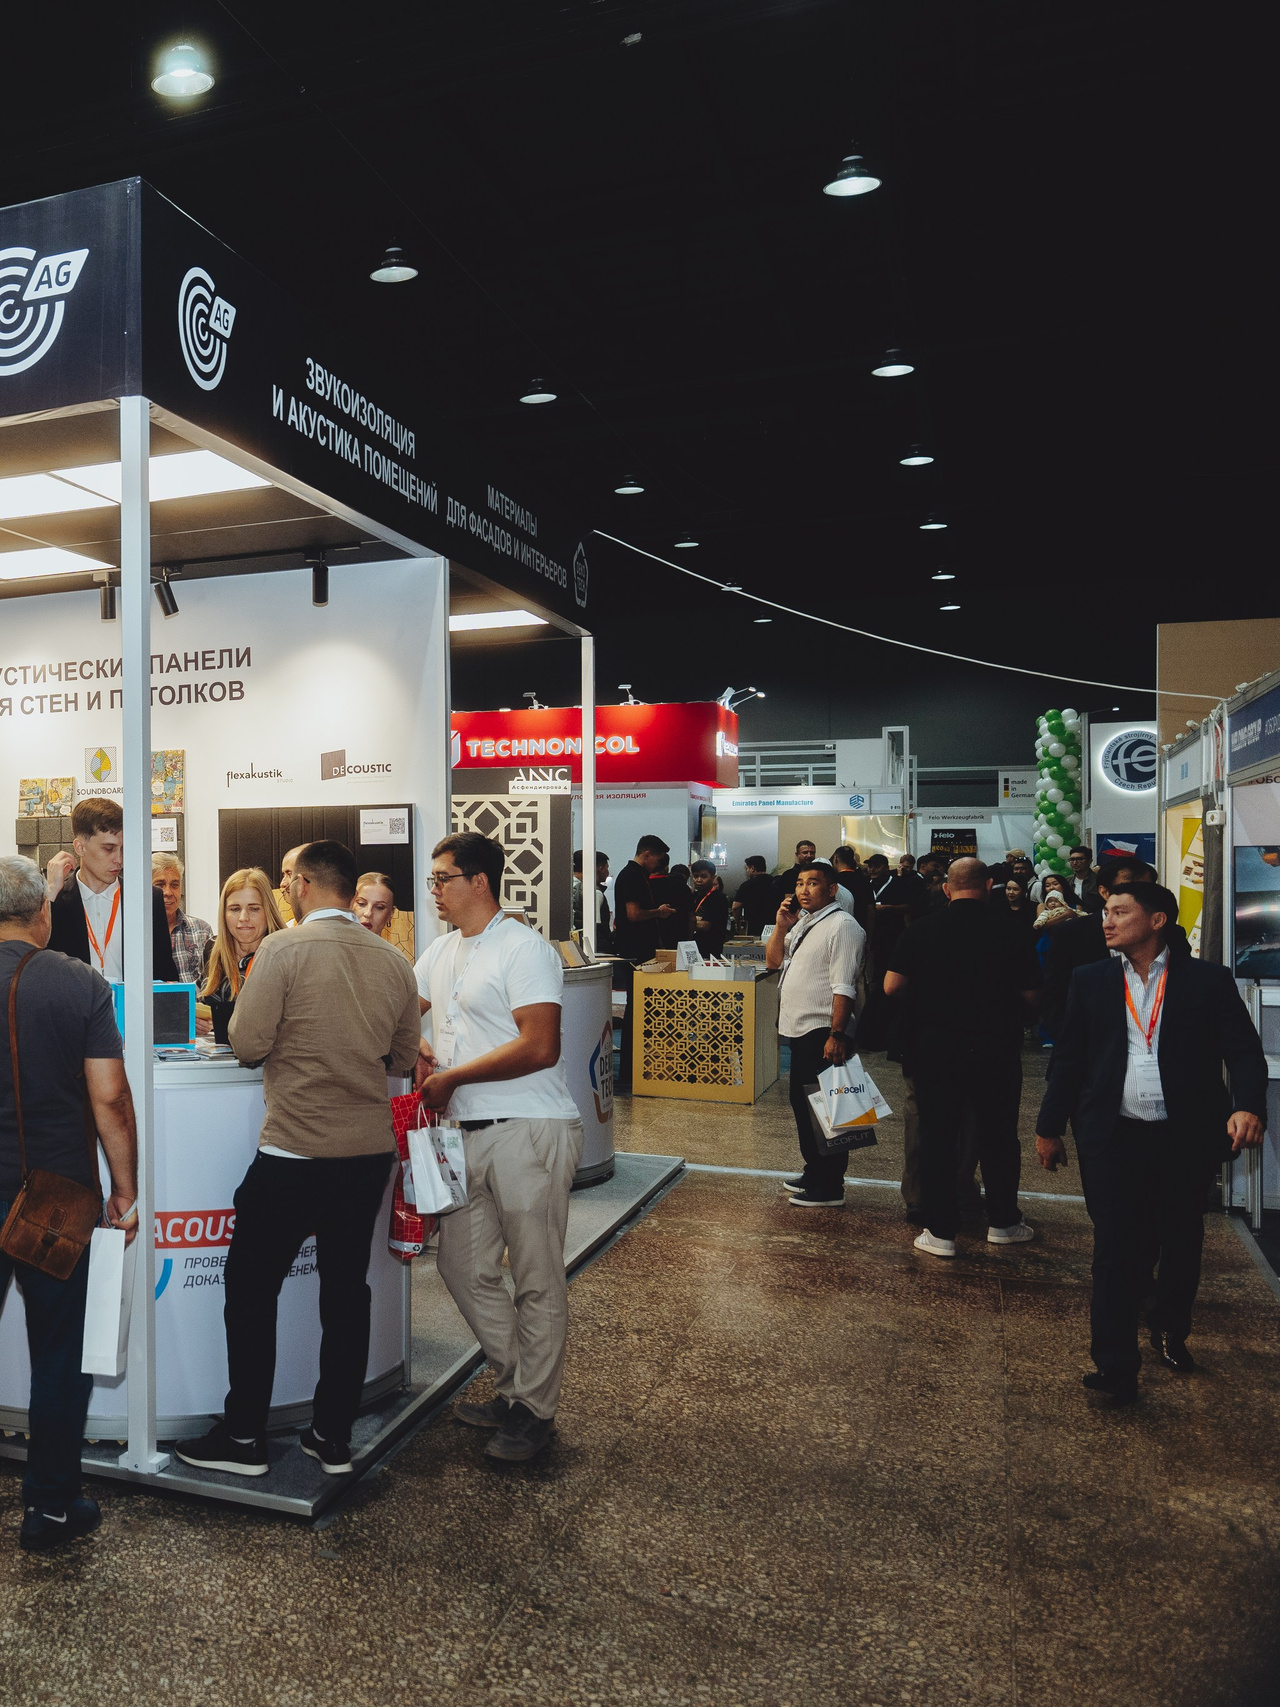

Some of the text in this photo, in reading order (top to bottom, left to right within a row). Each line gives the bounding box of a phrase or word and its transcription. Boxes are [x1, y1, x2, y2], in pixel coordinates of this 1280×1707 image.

[34, 260, 72, 292] AG
[214, 303, 231, 331] AG
[305, 357, 416, 460] ЗВУКОИЗОЛЯЦИЯ
[272, 384, 438, 515] И АКУСТИКА ПОМЕЩЕНИЙ
[487, 484, 538, 538] МАТЕРИАЛЫ
[446, 496, 567, 588] ДЛЯ ФАСАДОВ И ИНТЕРЬЕРОВ
[150, 647, 252, 675] ПАНЕЛИ
[20, 691, 79, 715] СТЕН
[86, 690, 102, 711] И
[110, 680, 245, 709] ПТОЛКОВ
[465, 735, 640, 758] TECHNONCOL
[227, 762, 283, 788] flexakustik
[1114, 777, 1135, 790] Czech
[826, 1131, 870, 1148] ECOPLIT
[154, 1214, 236, 1243] ACOUS
